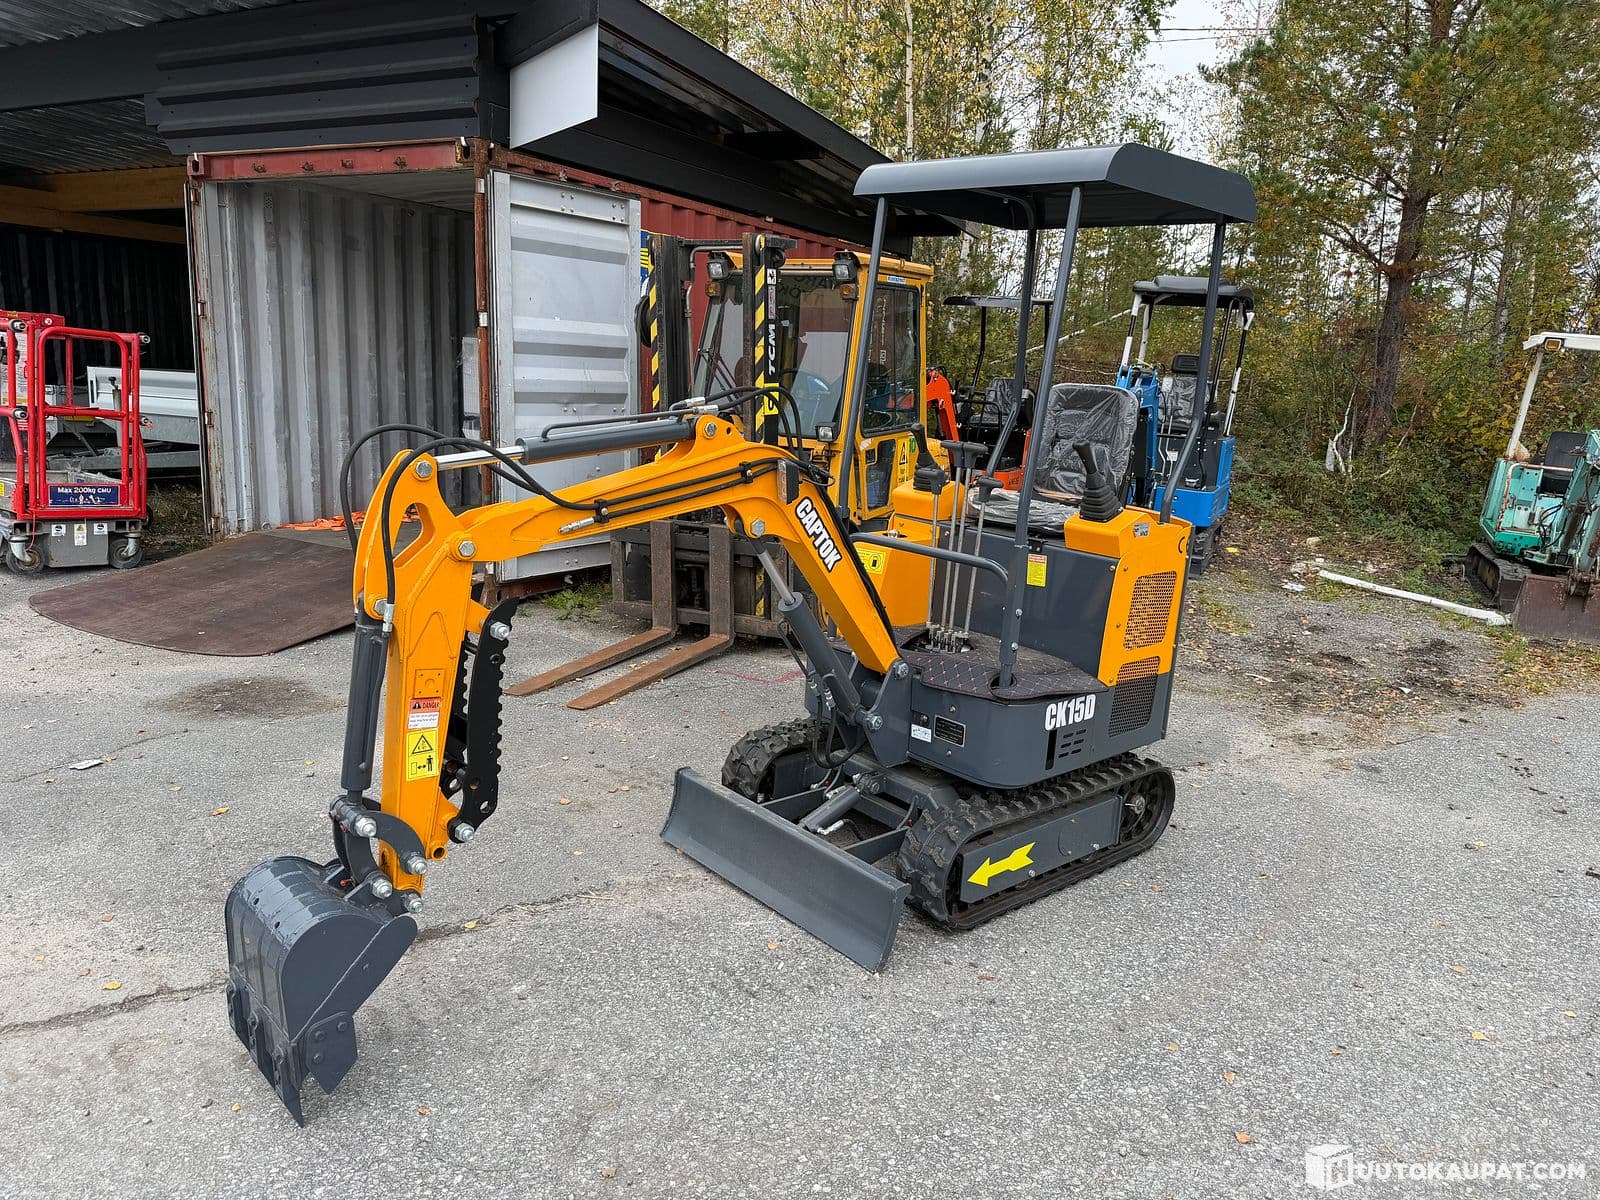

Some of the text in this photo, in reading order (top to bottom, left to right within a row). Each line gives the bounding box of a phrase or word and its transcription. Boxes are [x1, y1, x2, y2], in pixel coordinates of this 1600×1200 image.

[768, 324, 776, 376] TCM
[73, 487, 96, 495] 200kg
[795, 497, 843, 572] CAPTOK
[1044, 693, 1097, 731] CK15D
